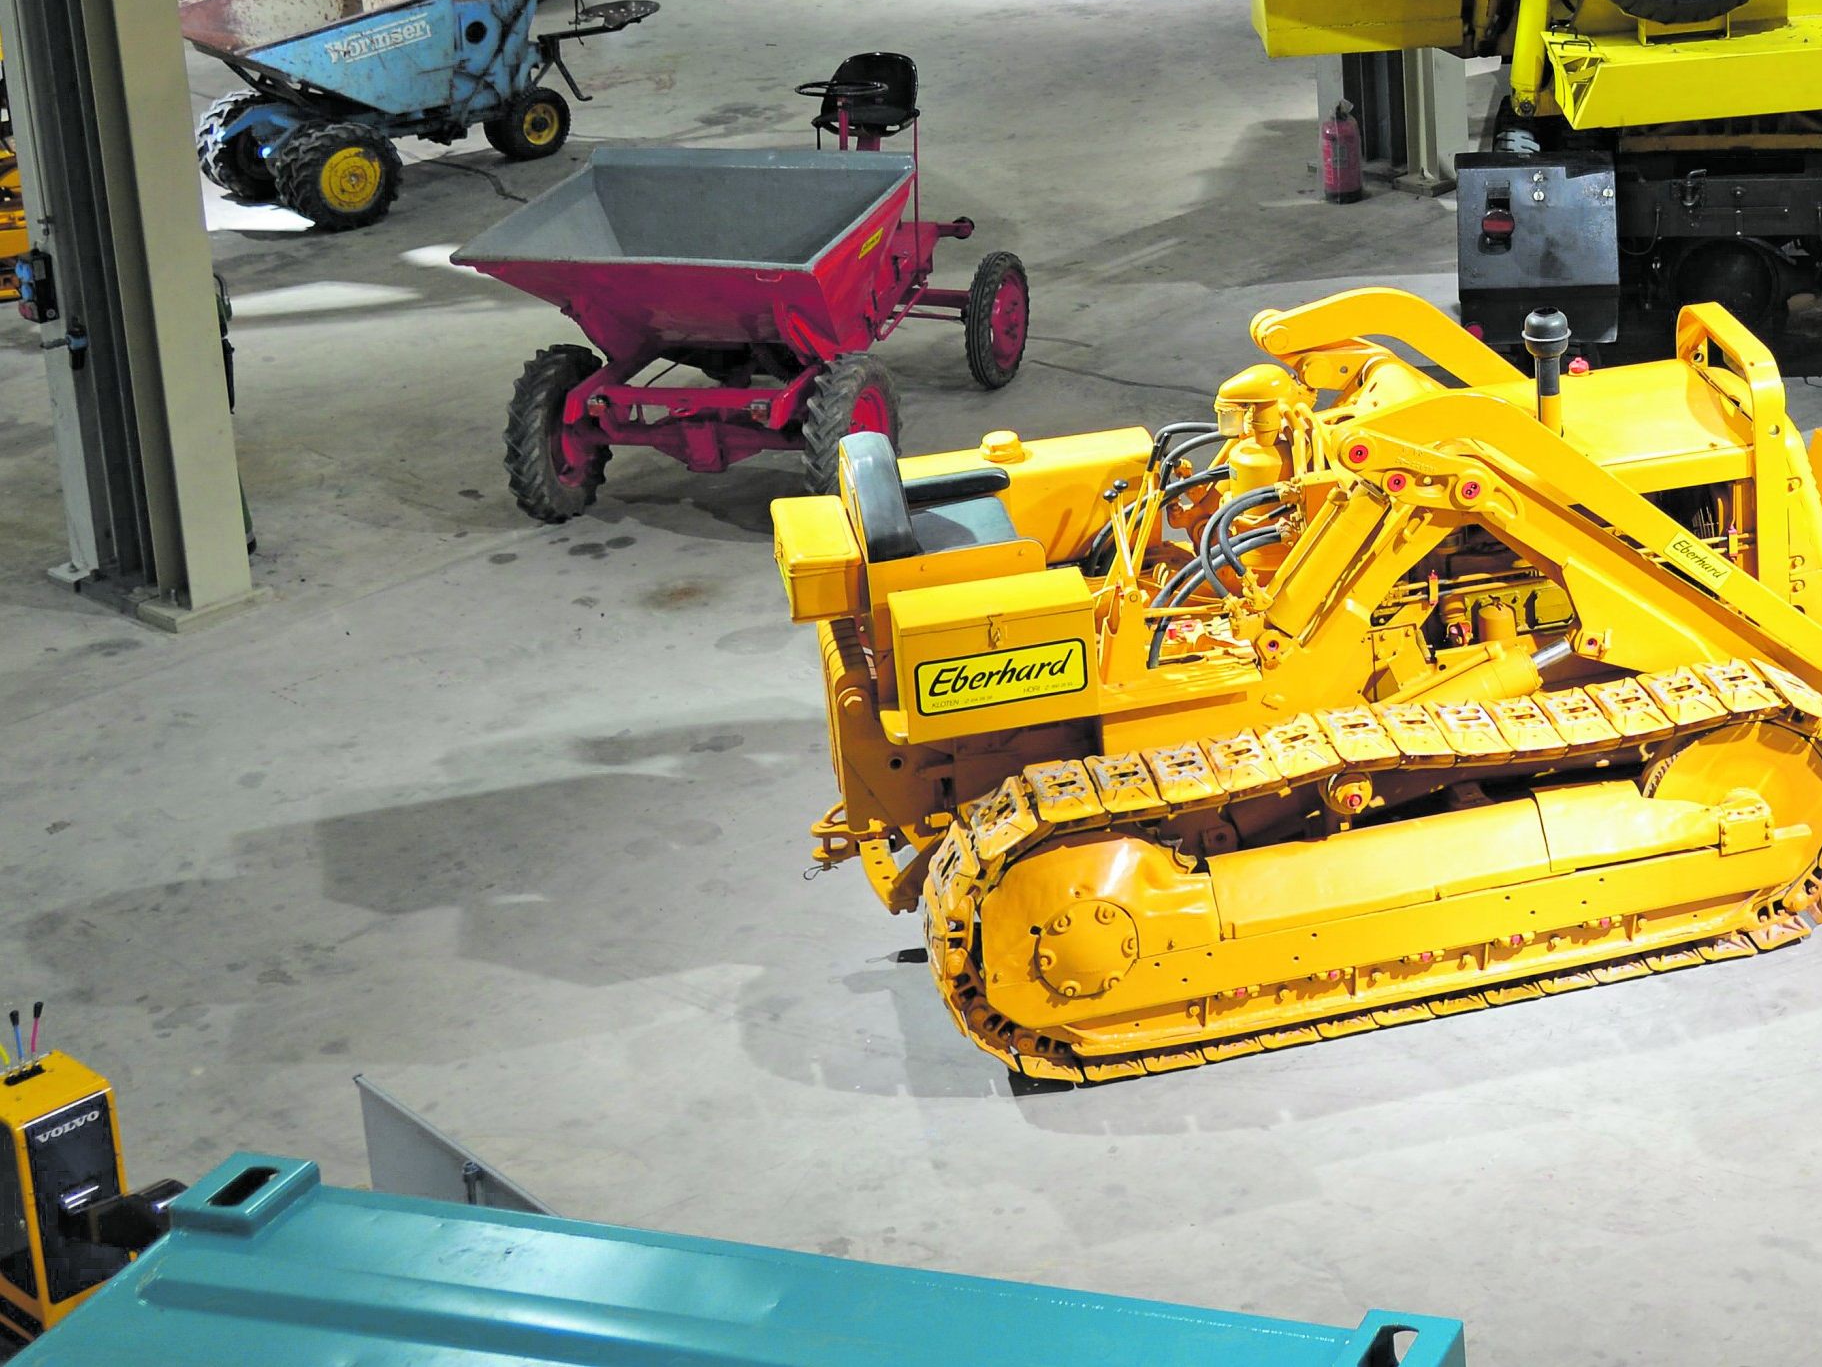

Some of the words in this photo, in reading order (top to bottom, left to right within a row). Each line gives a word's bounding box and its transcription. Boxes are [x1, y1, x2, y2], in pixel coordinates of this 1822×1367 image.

[324, 19, 426, 64] Wormser
[1672, 539, 1728, 579] Eberhard
[928, 648, 1074, 698] Eberhard
[35, 1110, 100, 1144] VOLVO
